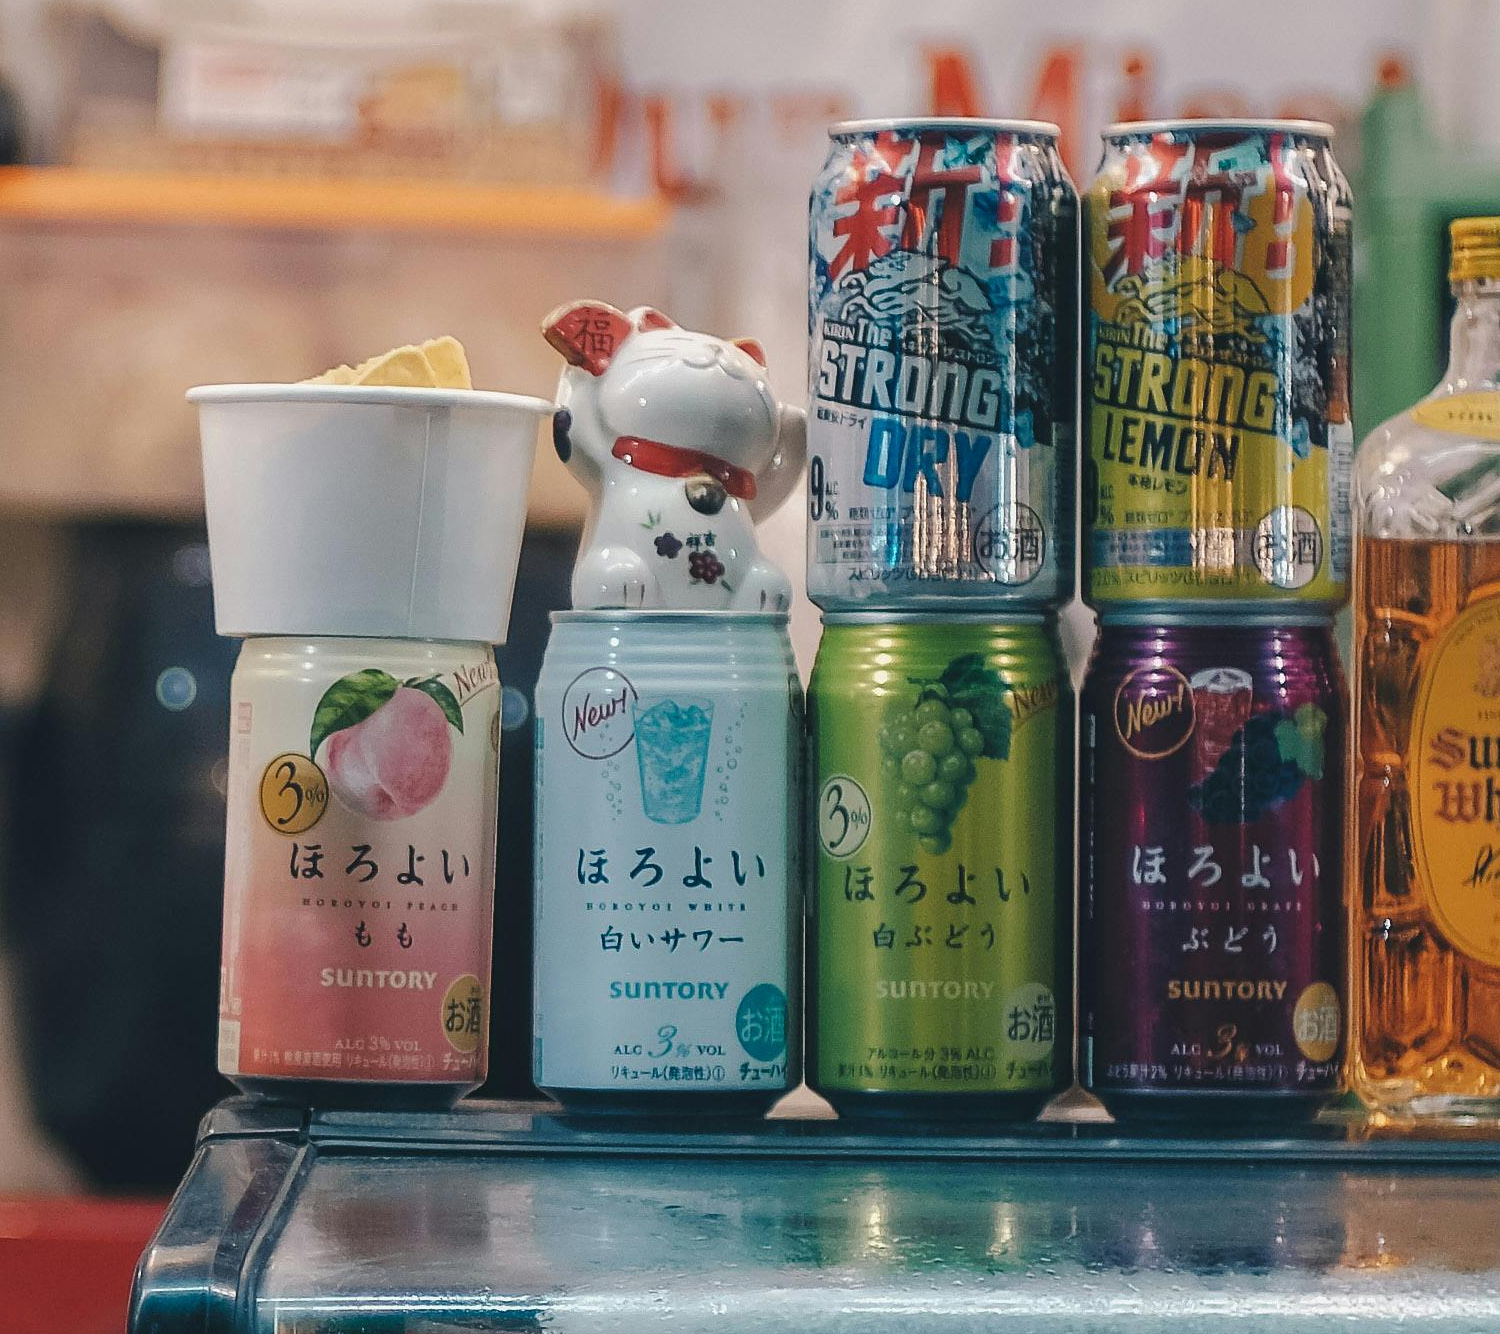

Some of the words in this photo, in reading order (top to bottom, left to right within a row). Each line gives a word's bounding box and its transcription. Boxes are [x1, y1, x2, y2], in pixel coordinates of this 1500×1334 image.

[857, 319, 891, 348] The
[817, 339, 1000, 429] STRONG
[1094, 341, 1278, 432] STRONG
[863, 418, 992, 504] DRY
[1103, 416, 1241, 481] LEMON
[277, 761, 327, 826] 3%
[824, 783, 869, 850] 3%
[290, 842, 471, 886] ほろよい
[577, 845, 767, 889] ほろよい
[842, 865, 1032, 905] ほろよい
[1131, 844, 1321, 886] ほろよい
[354, 920, 414, 949] もも
[600, 925, 744, 953] 白いサワー
[871, 923, 997, 950] 白ぶどう
[1181, 925, 1278, 953] ぶどう
[445, 997, 481, 1034] お酒
[741, 1003, 785, 1045] お酒
[1006, 1003, 1054, 1045] お酒
[393, 1040, 422, 1052] VOL
[613, 1043, 643, 1056] ALC
[696, 1043, 727, 1057] VOL
